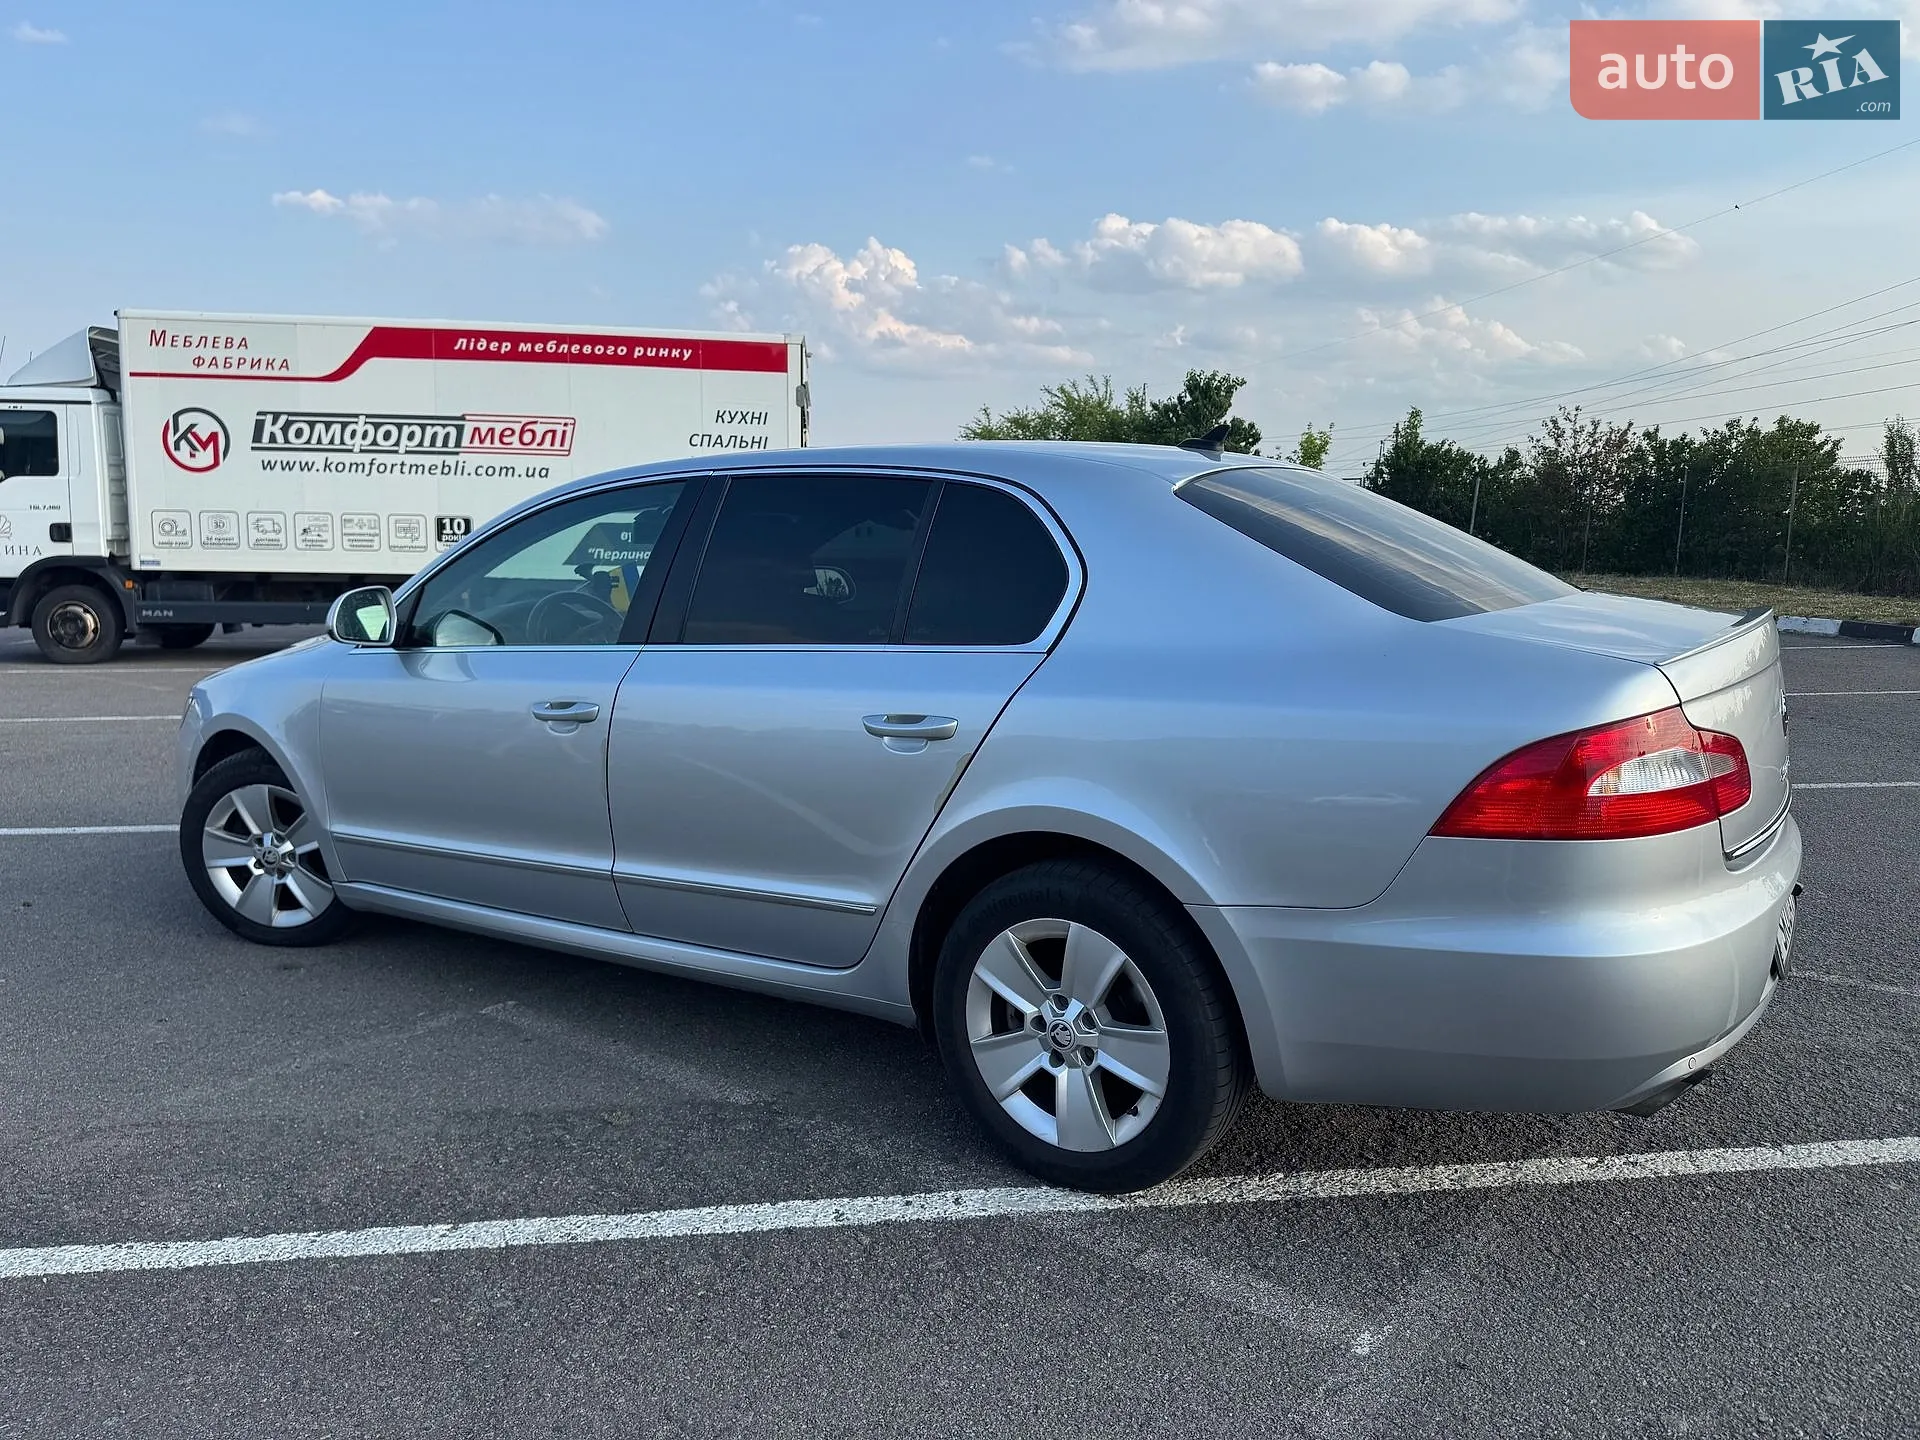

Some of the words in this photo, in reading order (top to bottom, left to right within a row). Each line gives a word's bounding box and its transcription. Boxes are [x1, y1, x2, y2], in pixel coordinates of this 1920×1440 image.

[454, 337, 512, 354] Лідер
[518, 341, 627, 357] меблевого
[633, 345, 693, 361] ринку
[192, 355, 290, 372] ФАБРИКА
[715, 409, 768, 426] КУХНІ
[261, 413, 457, 455] Комфорт
[469, 420, 569, 448] меблі
[689, 433, 768, 450] СПАЛЬНІ
[261, 456, 550, 479] www.komfortmebli.com.ua
[442, 518, 466, 535] 10
[142, 609, 174, 617] MAN
